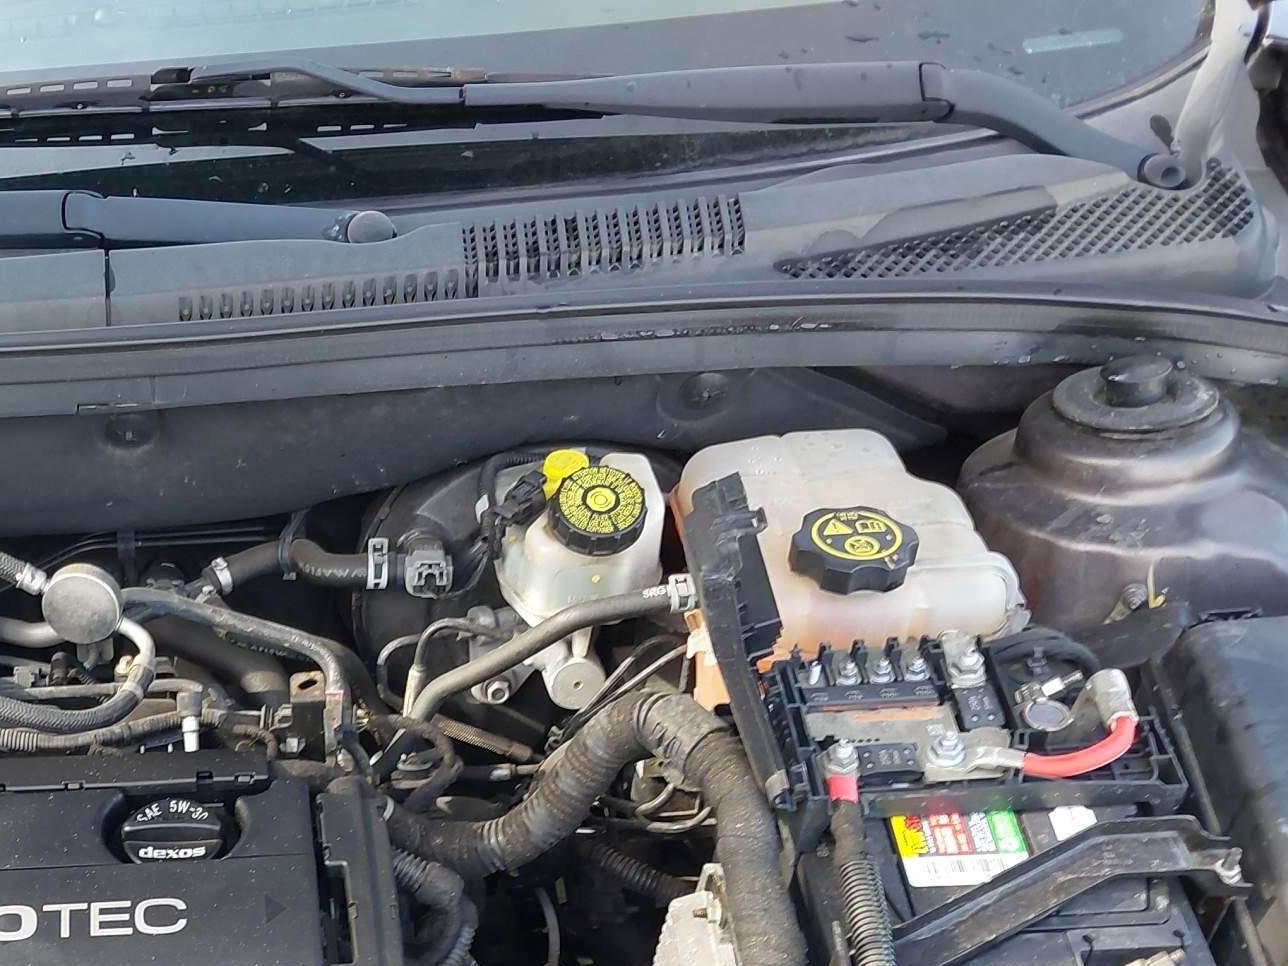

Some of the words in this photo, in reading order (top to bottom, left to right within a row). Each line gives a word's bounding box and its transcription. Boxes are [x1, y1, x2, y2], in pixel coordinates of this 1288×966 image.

[642, 585, 667, 598] SRG
[136, 803, 163, 822] SAE
[138, 846, 206, 859] dexos
